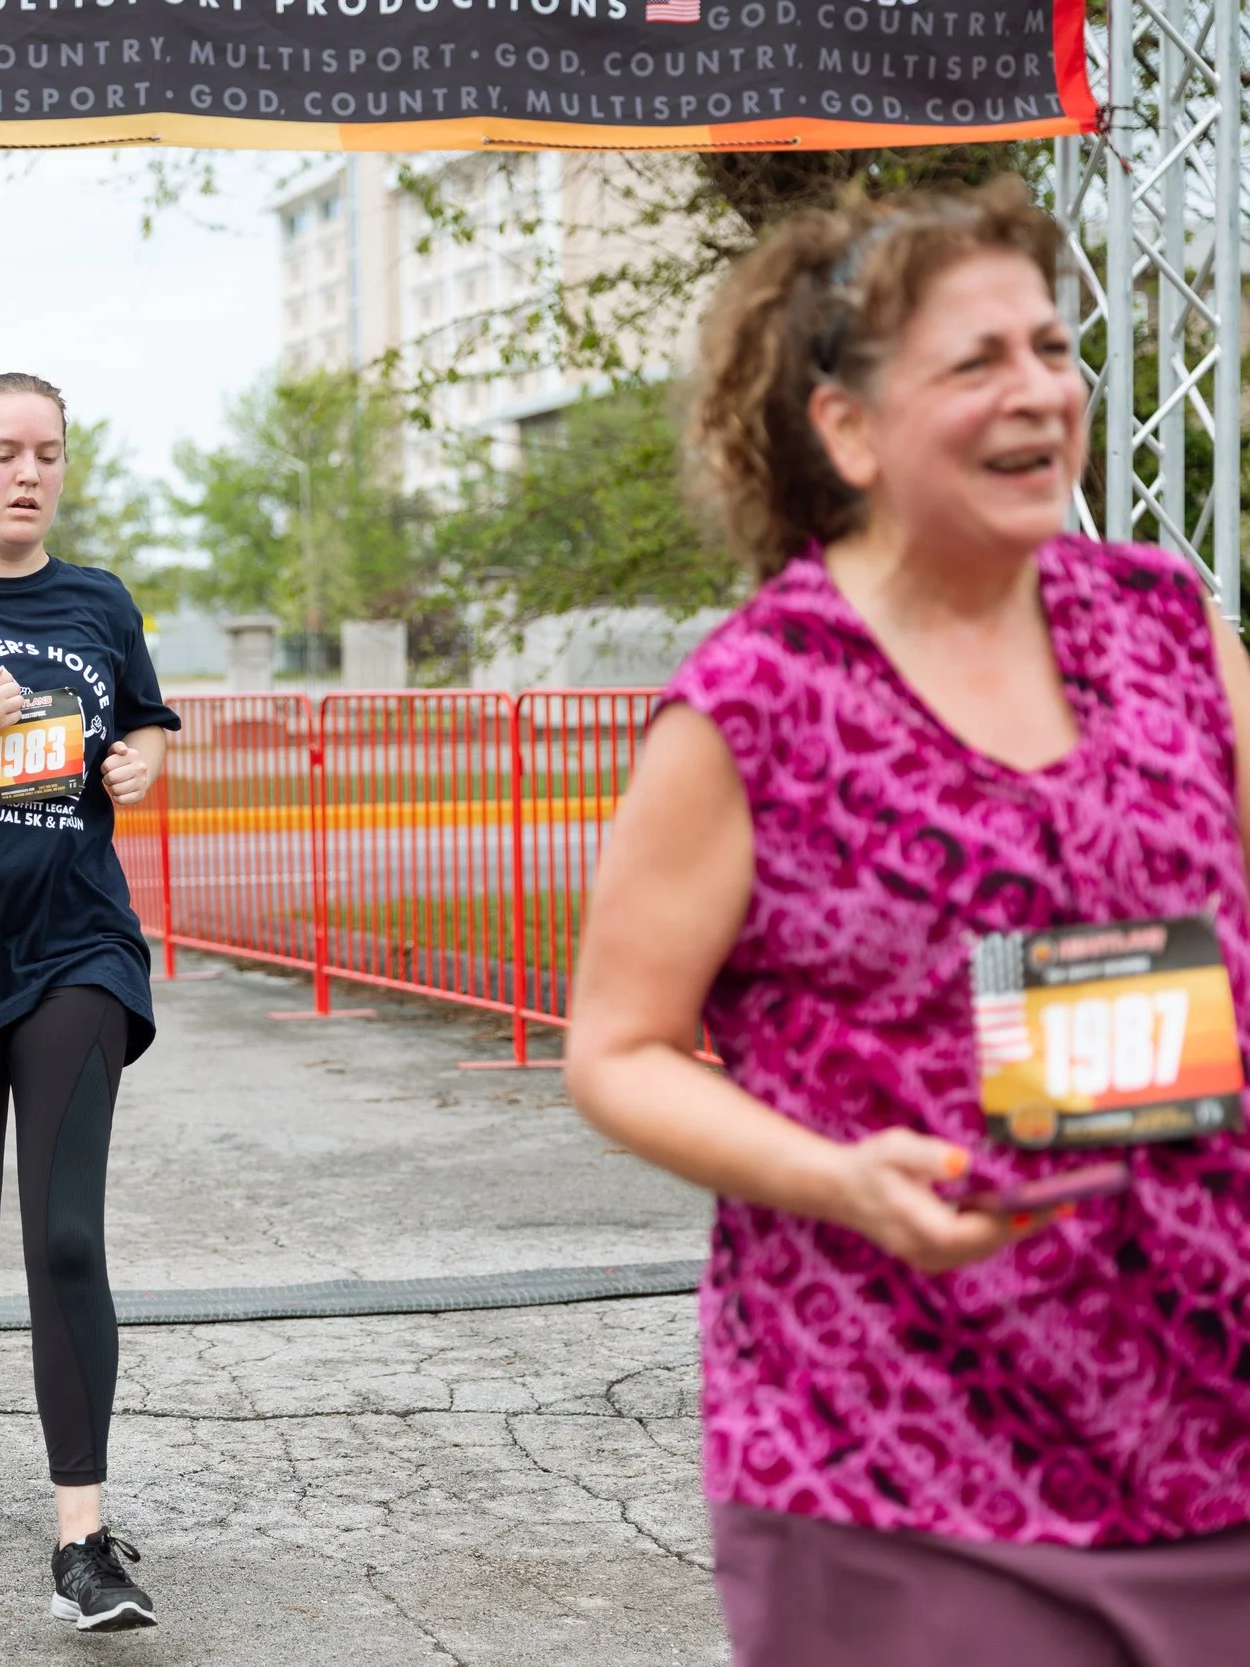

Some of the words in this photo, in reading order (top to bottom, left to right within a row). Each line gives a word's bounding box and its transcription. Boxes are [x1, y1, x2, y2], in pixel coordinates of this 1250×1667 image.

[275, 0, 627, 20] PRODUONS
[707, 1, 801, 31] GOD,
[817, 4, 1010, 37] COUNTRY,
[1023, 8, 1046, 34] M
[188, 40, 456, 73] MULTISPORT
[494, 43, 586, 76] GOD,
[603, 43, 803, 77] COUNTRY,
[817, 47, 1054, 80] MULTISPOR
[190, 84, 286, 116] GOD,
[304, 85, 509, 116] COUNTRY,
[526, 87, 785, 120] MULTISPORT
[820, 89, 910, 121] GOD,
[47, 646, 110, 710] HOUSE
[6, 801, 44, 812] OFFITT
[25, 812, 42, 827] 5K
[45, 816, 56, 829] &
[1041, 987, 1190, 1099] 1987
